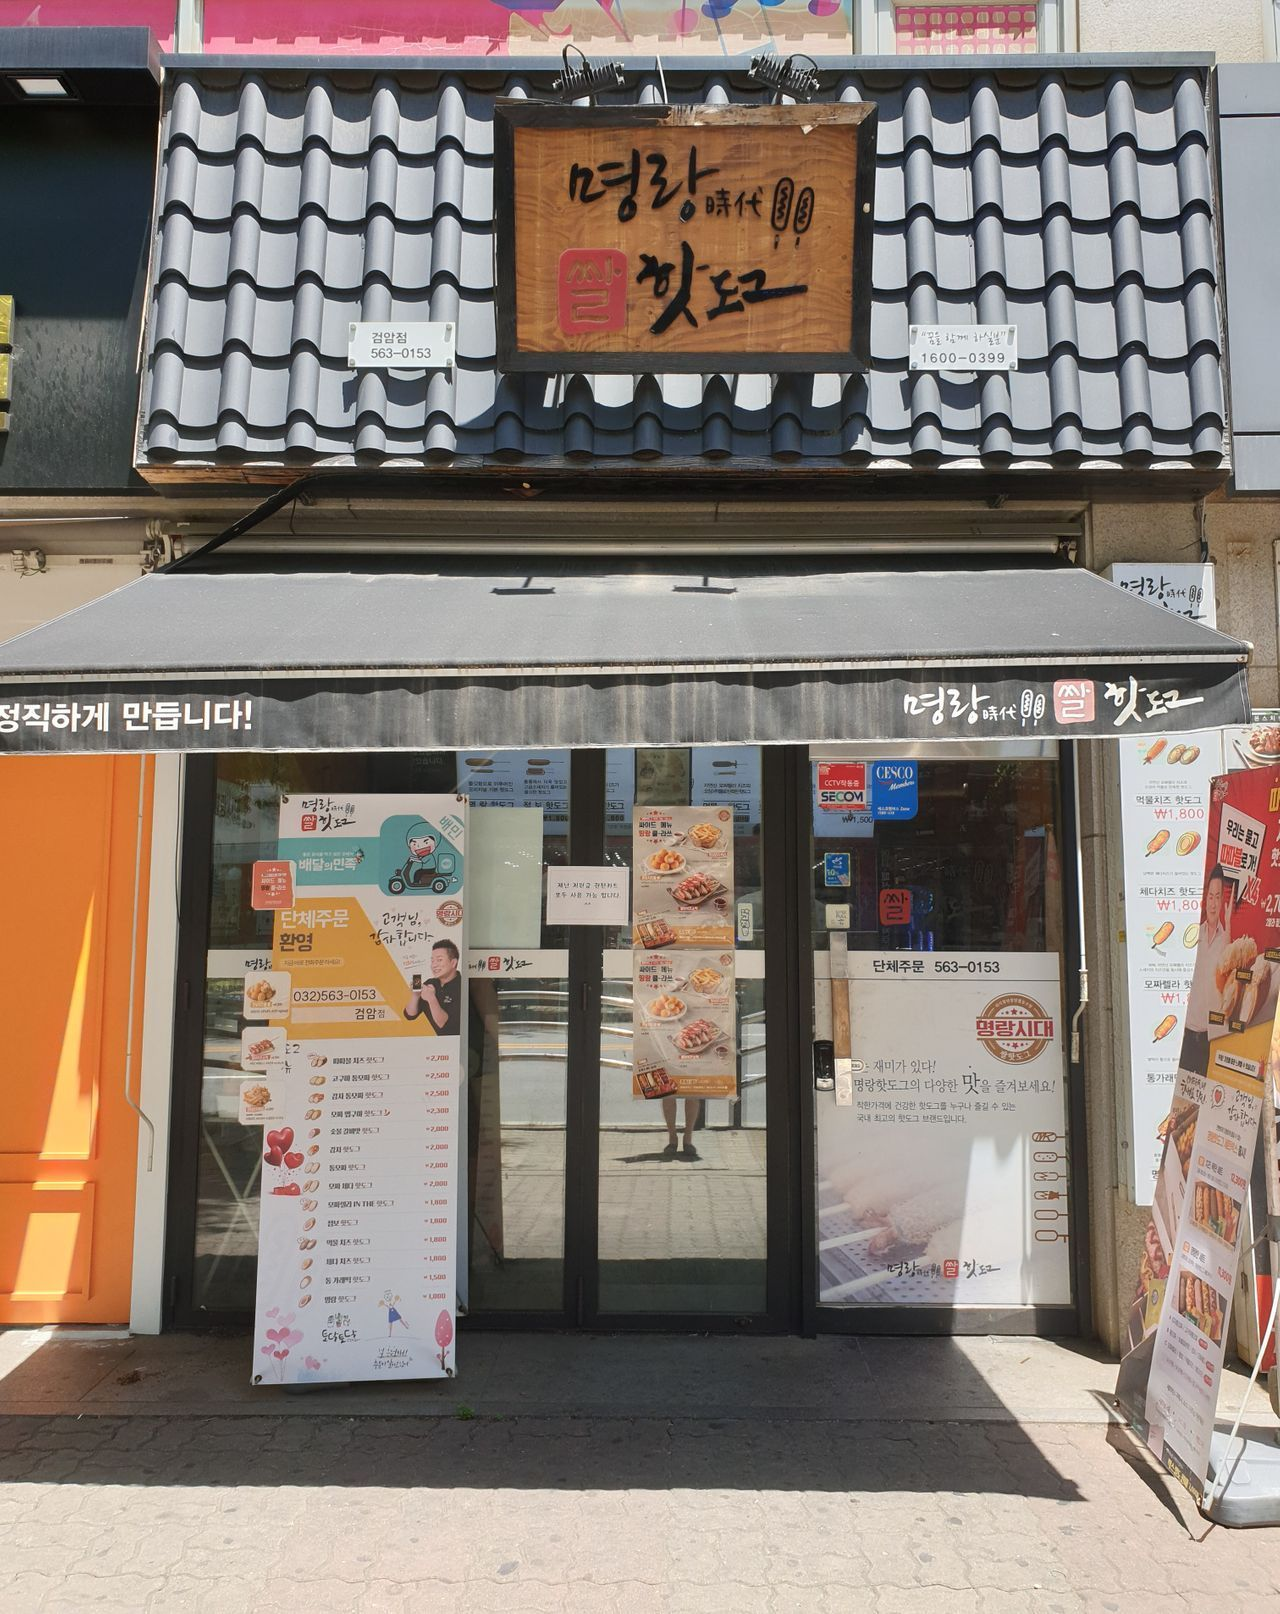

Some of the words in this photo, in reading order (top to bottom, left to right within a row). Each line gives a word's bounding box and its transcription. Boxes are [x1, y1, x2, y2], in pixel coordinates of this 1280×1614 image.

[569, 145, 720, 224] 명랑
[563, 253, 624, 328] 쌀
[636, 240, 808, 334] 핫도그
[372, 332, 407, 344] 검암점
[371, 348, 431, 359] 563-0153
[922, 352, 1005, 363] 1600-0399
[904, 685, 990, 726] 명랑
[1056, 682, 1092, 721] 쌀
[1104, 676, 1204, 727] 핫도그
[0, 702, 109, 733] 정직하게
[123, 700, 252, 731] 만듭니다!
[876, 766, 914, 779] CESCO
[821, 791, 863, 802] SECOM
[1136, 796, 1172, 804] 먹물치즈
[1176, 795, 1201, 805] 핫도그
[1153, 808, 1204, 820] ₩1,800
[319, 813, 356, 831] 핫도그
[439, 815, 463, 839] 배민
[1226, 819, 1245, 842] 우리는
[299, 857, 357, 871] 배달의민족
[1140, 887, 1176, 896] 체다치즈
[281, 910, 350, 929] 단체주문
[280, 932, 313, 952] 환영
[503, 956, 533, 971] 핫도그
[873, 960, 925, 973] 단체주문
[935, 961, 1000, 973] 563-0153
[1144, 980, 1180, 989] 모짜렐라
[294, 988, 377, 1002] 032)563-0153
[355, 1006, 386, 1020] 검암점
[976, 1021, 1054, 1036] 명랑시대
[873, 1060, 907, 1074] 재미가
[910, 1060, 936, 1074] 있다!
[854, 1078, 920, 1093] 명랑핫도그의
[924, 1079, 958, 1093] 다양한
[962, 1071, 990, 1095] 맛을
[995, 1079, 1056, 1093] 즐겨보세요!
[1147, 1074, 1178, 1083] 통가래
[856, 1101, 892, 1111] 착한가격에
[895, 1101, 916, 1111] 건강한
[919, 1101, 947, 1111] 핫도그를
[950, 1101, 972, 1111] 누구나
[991, 1102, 999, 1111] 수
[1001, 1102, 1016, 1111] 있는
[856, 1113, 871, 1123] 국내
[875, 1113, 895, 1123] 최고의
[899, 1113, 920, 1123] 핫도그
[923, 1114, 968, 1124] 브랜드입니다.
[963, 1259, 1001, 1279] 핫도그
